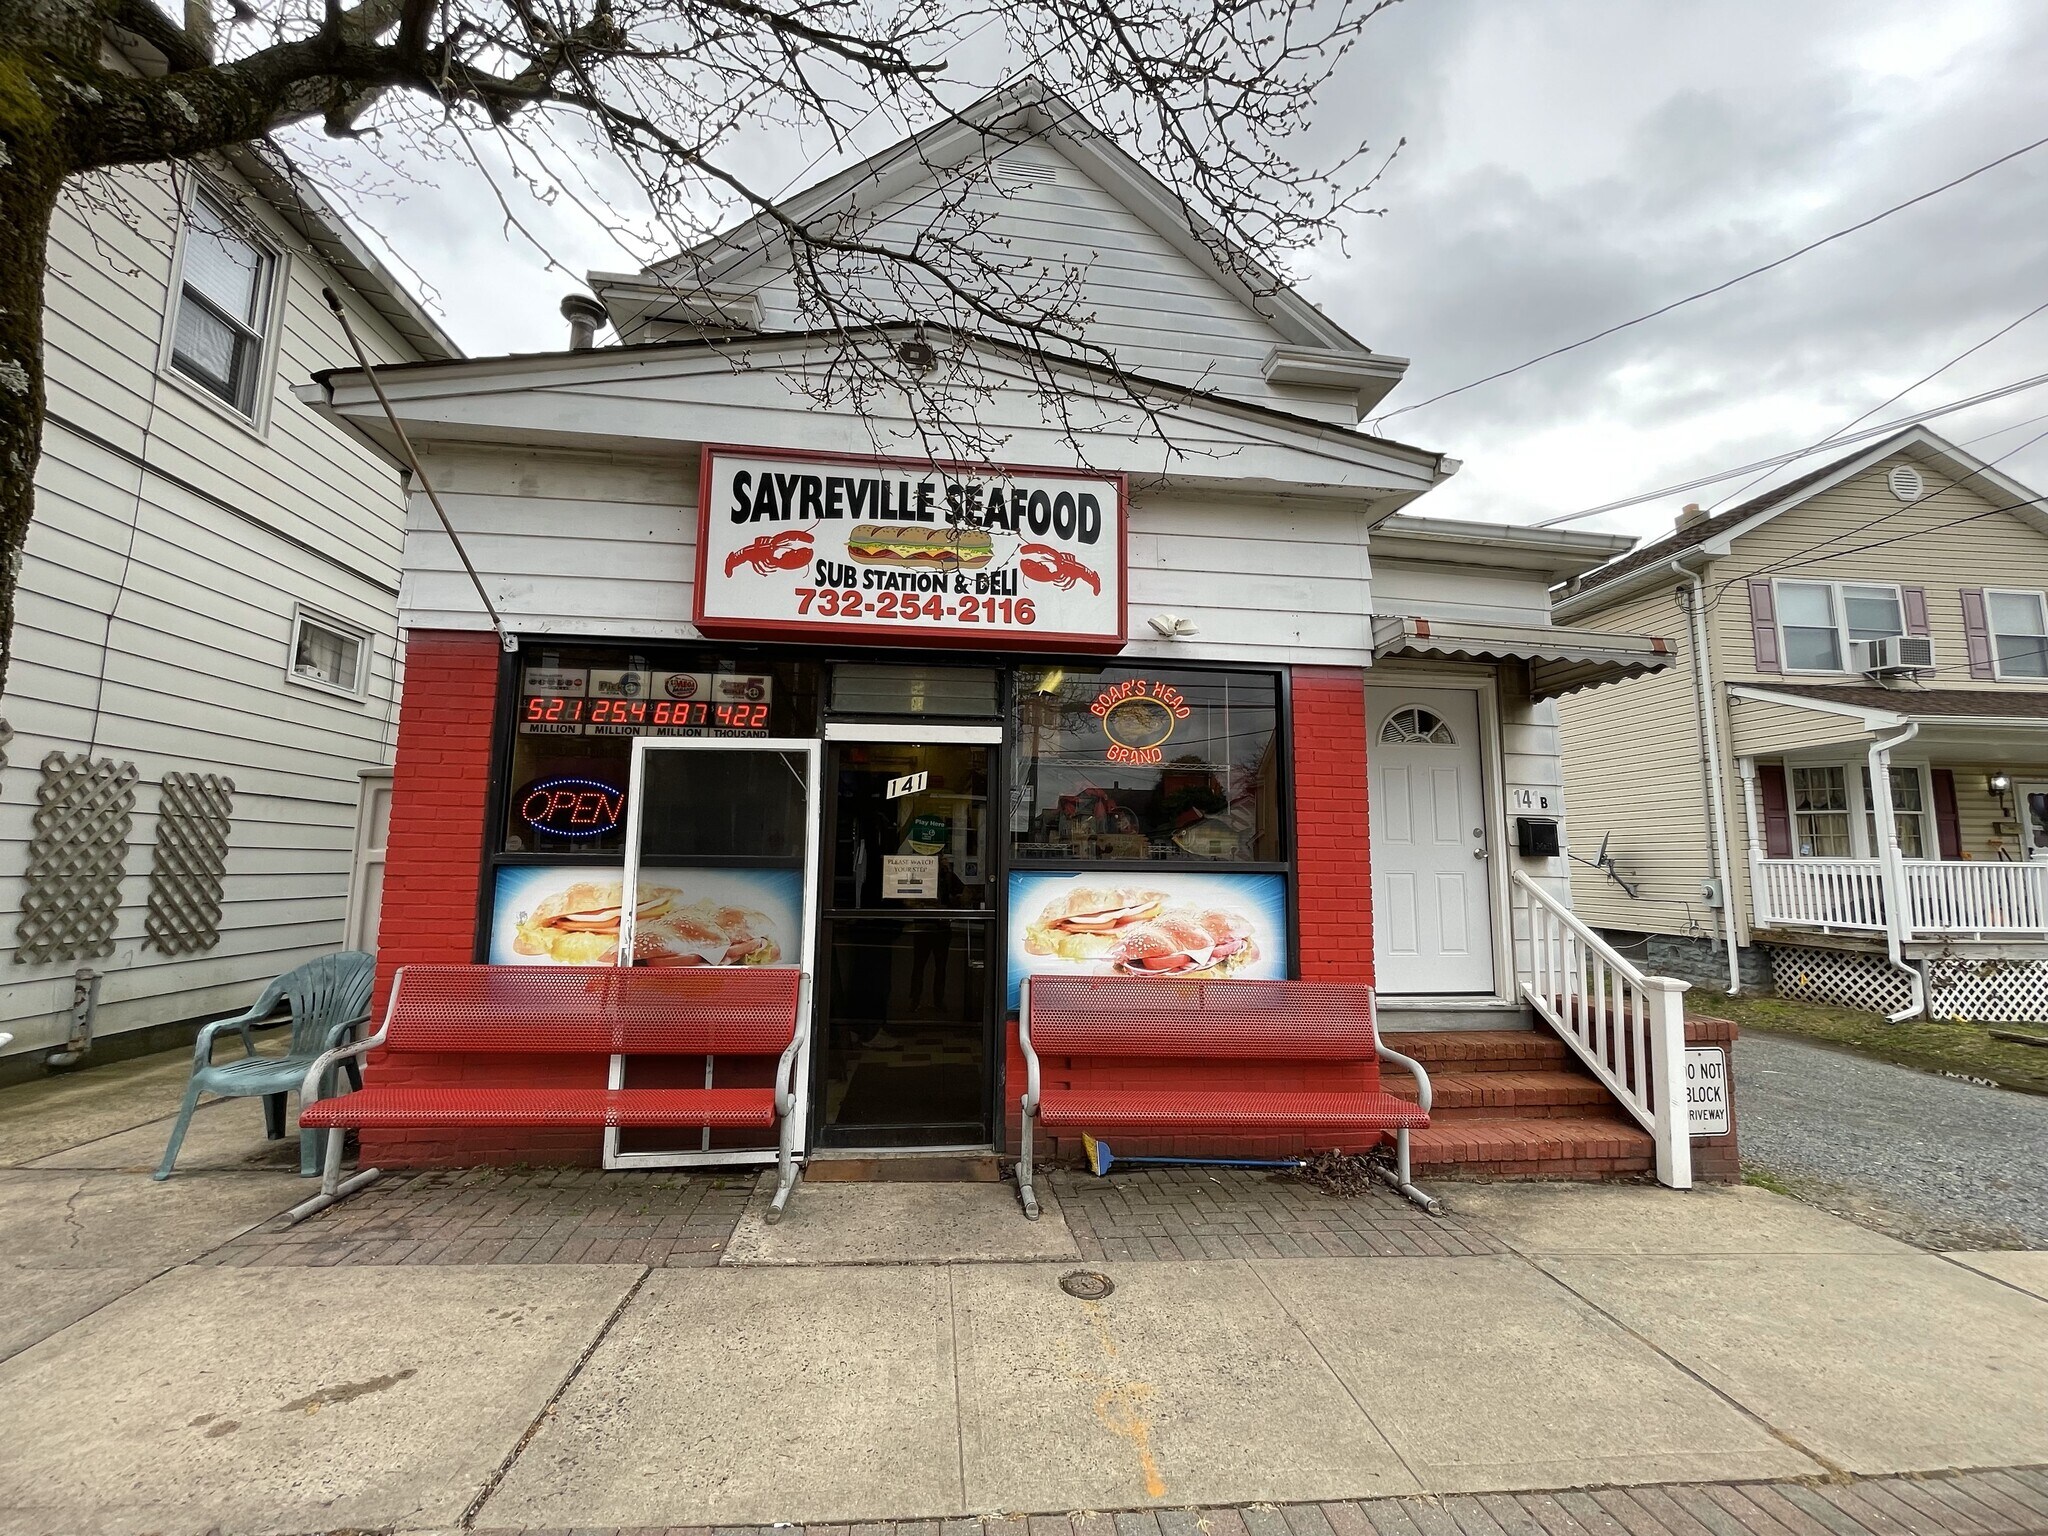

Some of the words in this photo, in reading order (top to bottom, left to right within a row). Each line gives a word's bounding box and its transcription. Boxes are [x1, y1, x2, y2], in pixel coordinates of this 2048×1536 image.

[730, 470, 936, 524] SAYREVILLE
[944, 484, 1101, 545] SEAFOOD
[814, 559, 858, 589] SUB
[862, 568, 948, 594] STATION
[953, 573, 970, 594] &
[975, 570, 1018, 597] DELI
[795, 588, 1037, 625] 732-254-2116
[527, 698, 583, 720] 521
[1090, 679, 1147, 717] BOAR'S
[1152, 681, 1191, 719] HEAD
[591, 701, 647, 723] 25.4
[653, 702, 708, 724] 687
[717, 705, 768, 727] 422
[529, 724, 576, 734] MILLION
[594, 726, 640, 736] MILLION
[656, 728, 702, 738] MILLION
[713, 729, 767, 739] THOUSAND
[1106, 744, 1162, 766] BRAND
[891, 773, 923, 797] 141
[522, 791, 624, 824] OPEN
[1540, 796, 1548, 809] B
[915, 819, 931, 829] Play
[929, 821, 945, 829] Here
[1686, 1063, 1695, 1079] O
[1700, 1063, 1721, 1079] NOT
[1687, 1086, 1722, 1103] BLOCK
[1689, 1109, 1724, 1120] RIVEWAY
